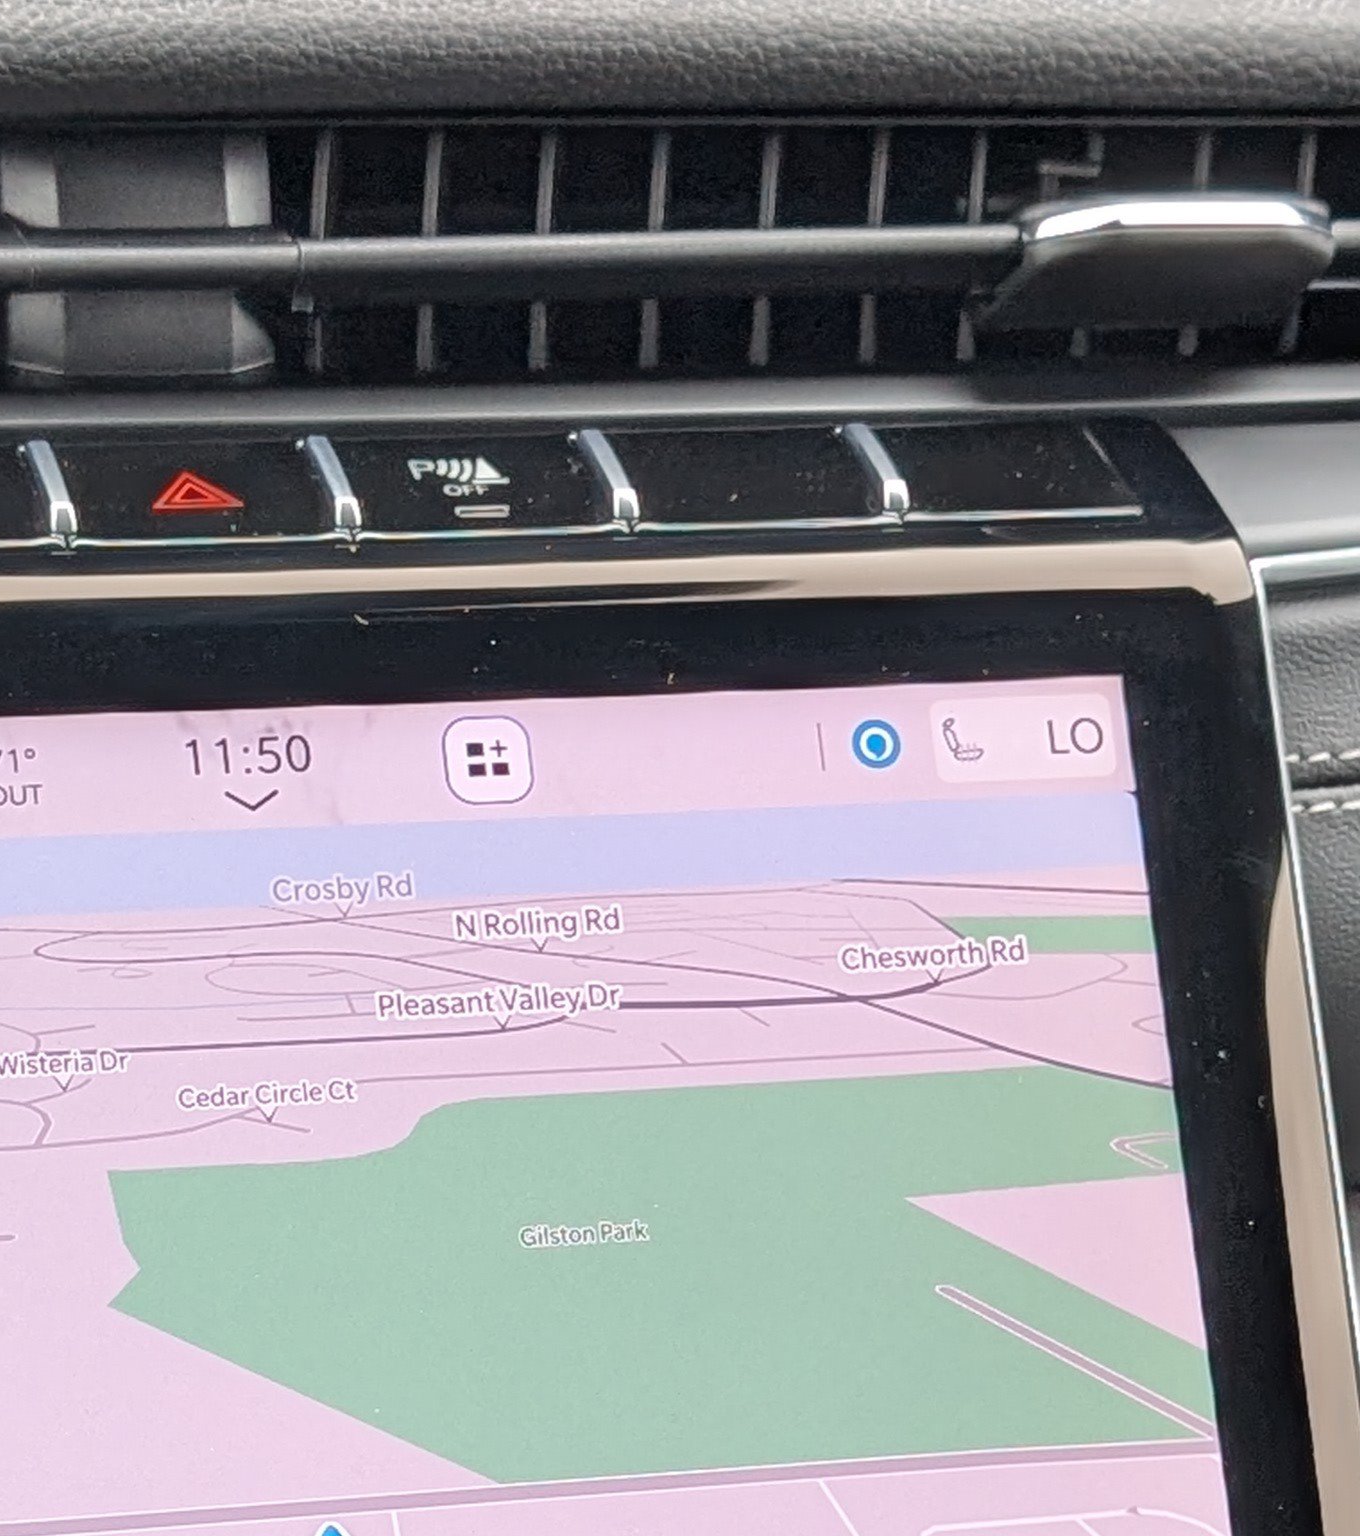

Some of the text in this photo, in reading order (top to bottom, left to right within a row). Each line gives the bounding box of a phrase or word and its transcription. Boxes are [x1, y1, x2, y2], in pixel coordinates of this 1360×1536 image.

[443, 484, 490, 497] OFF
[1047, 717, 1104, 755] LO
[185, 734, 312, 776] 11:50
[272, 874, 413, 905] Crosby Rd
[456, 907, 621, 940] N Rolling Rd
[841, 938, 1026, 971] Chesworth Rd
[378, 985, 620, 1018] Pleasant Valley Dr
[100, 1052, 129, 1071] Dr
[178, 1081, 356, 1109] Cedar Circle Ct
[520, 1220, 647, 1246] Gilston Park
